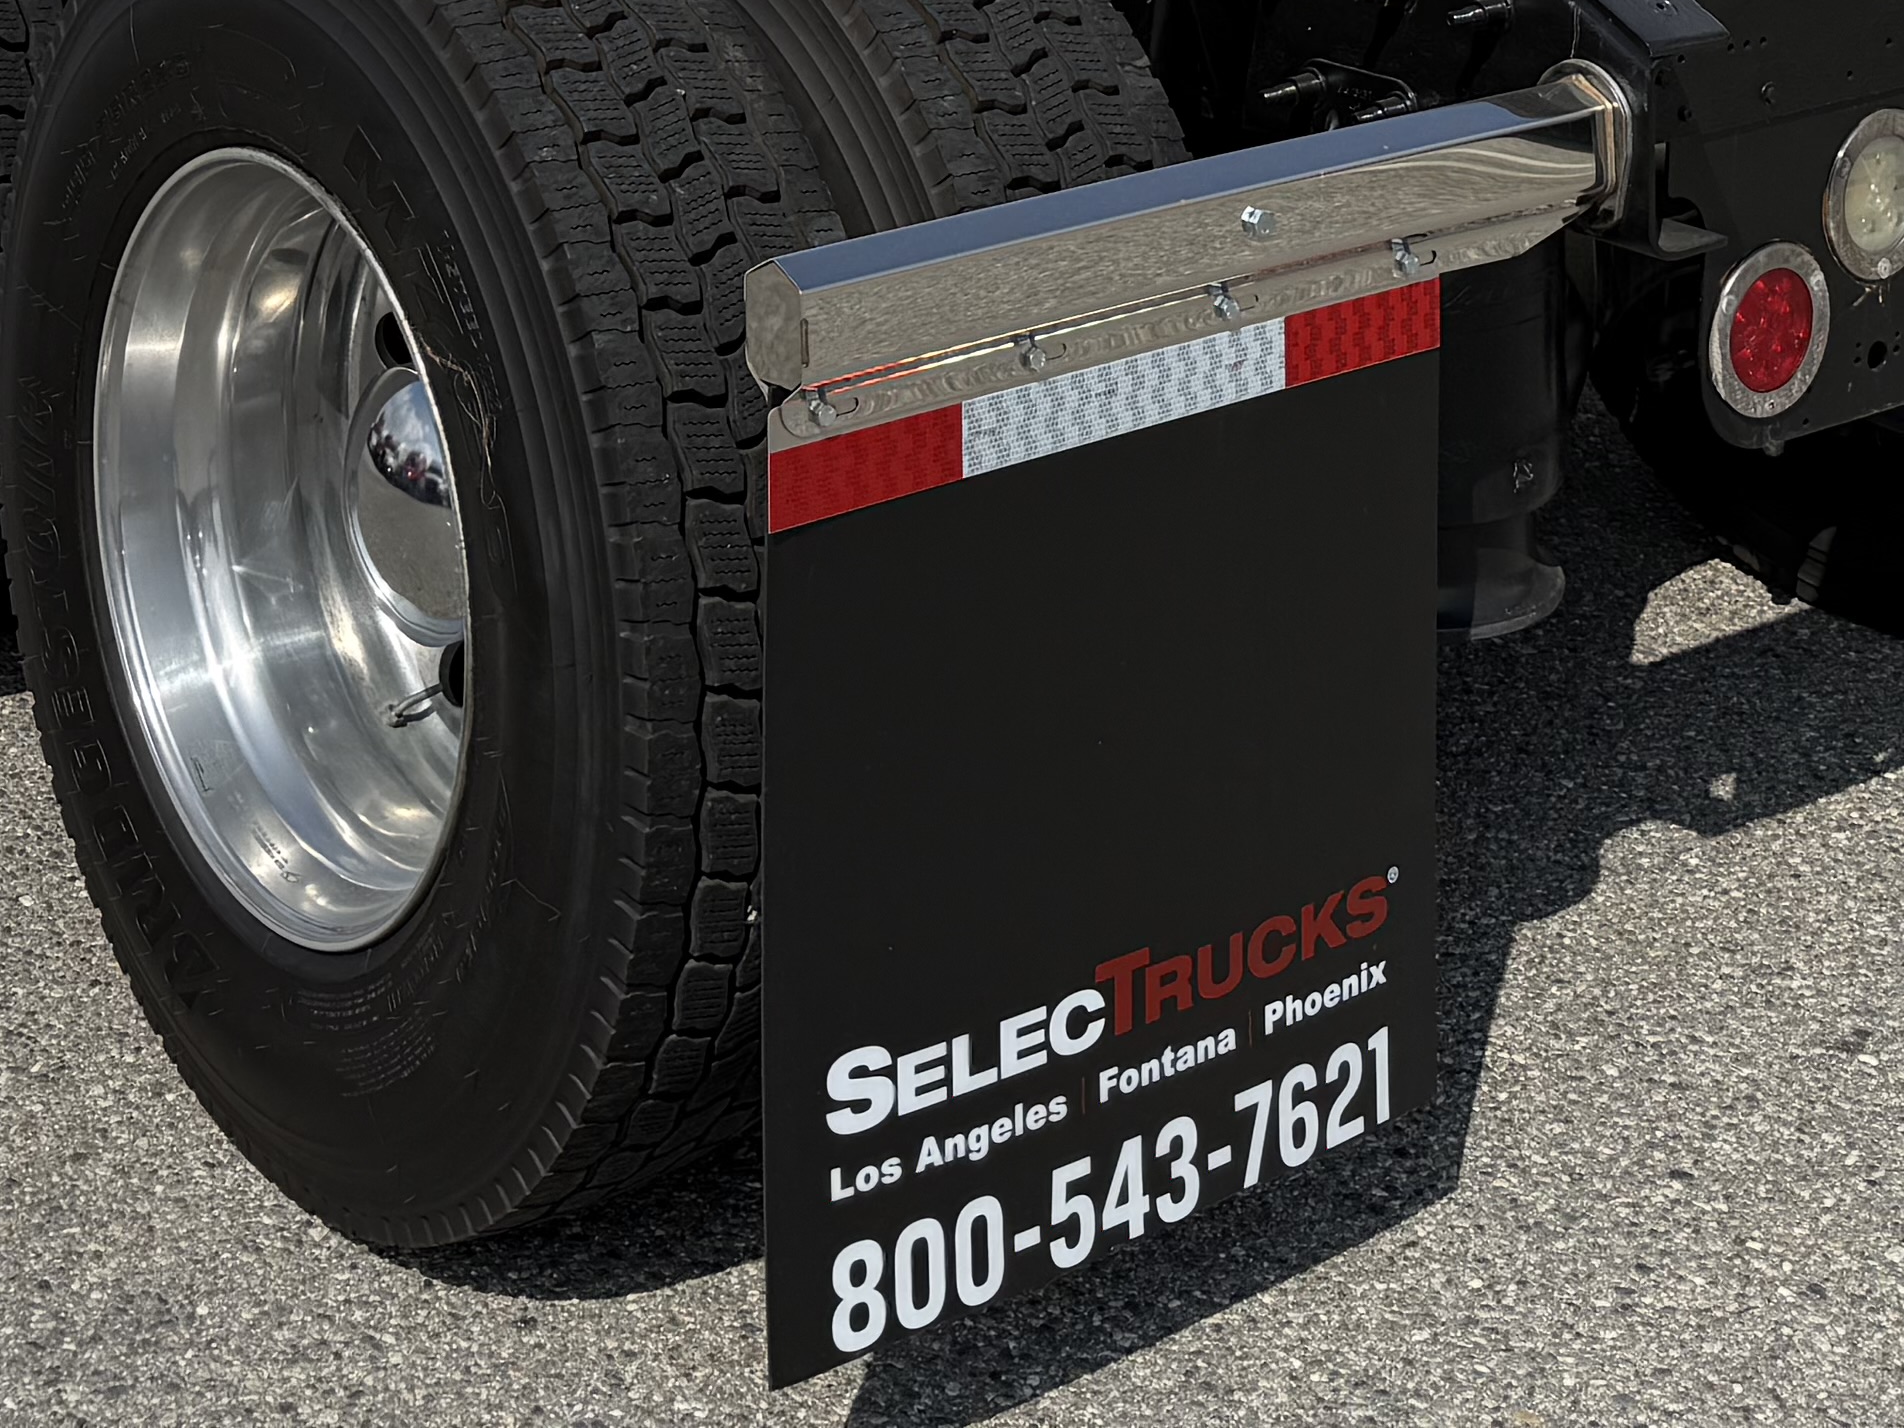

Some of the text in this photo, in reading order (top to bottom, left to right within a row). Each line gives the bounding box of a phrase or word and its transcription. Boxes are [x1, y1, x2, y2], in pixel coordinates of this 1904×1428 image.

[15, 374, 221, 1012] BRIDGESTONE
[824, 874, 1388, 1136] SELECTRUCKS
[829, 957, 1388, 1203] Los Angeles Fontana Phoenix
[830, 1025, 1391, 1353] 800-543-7621
